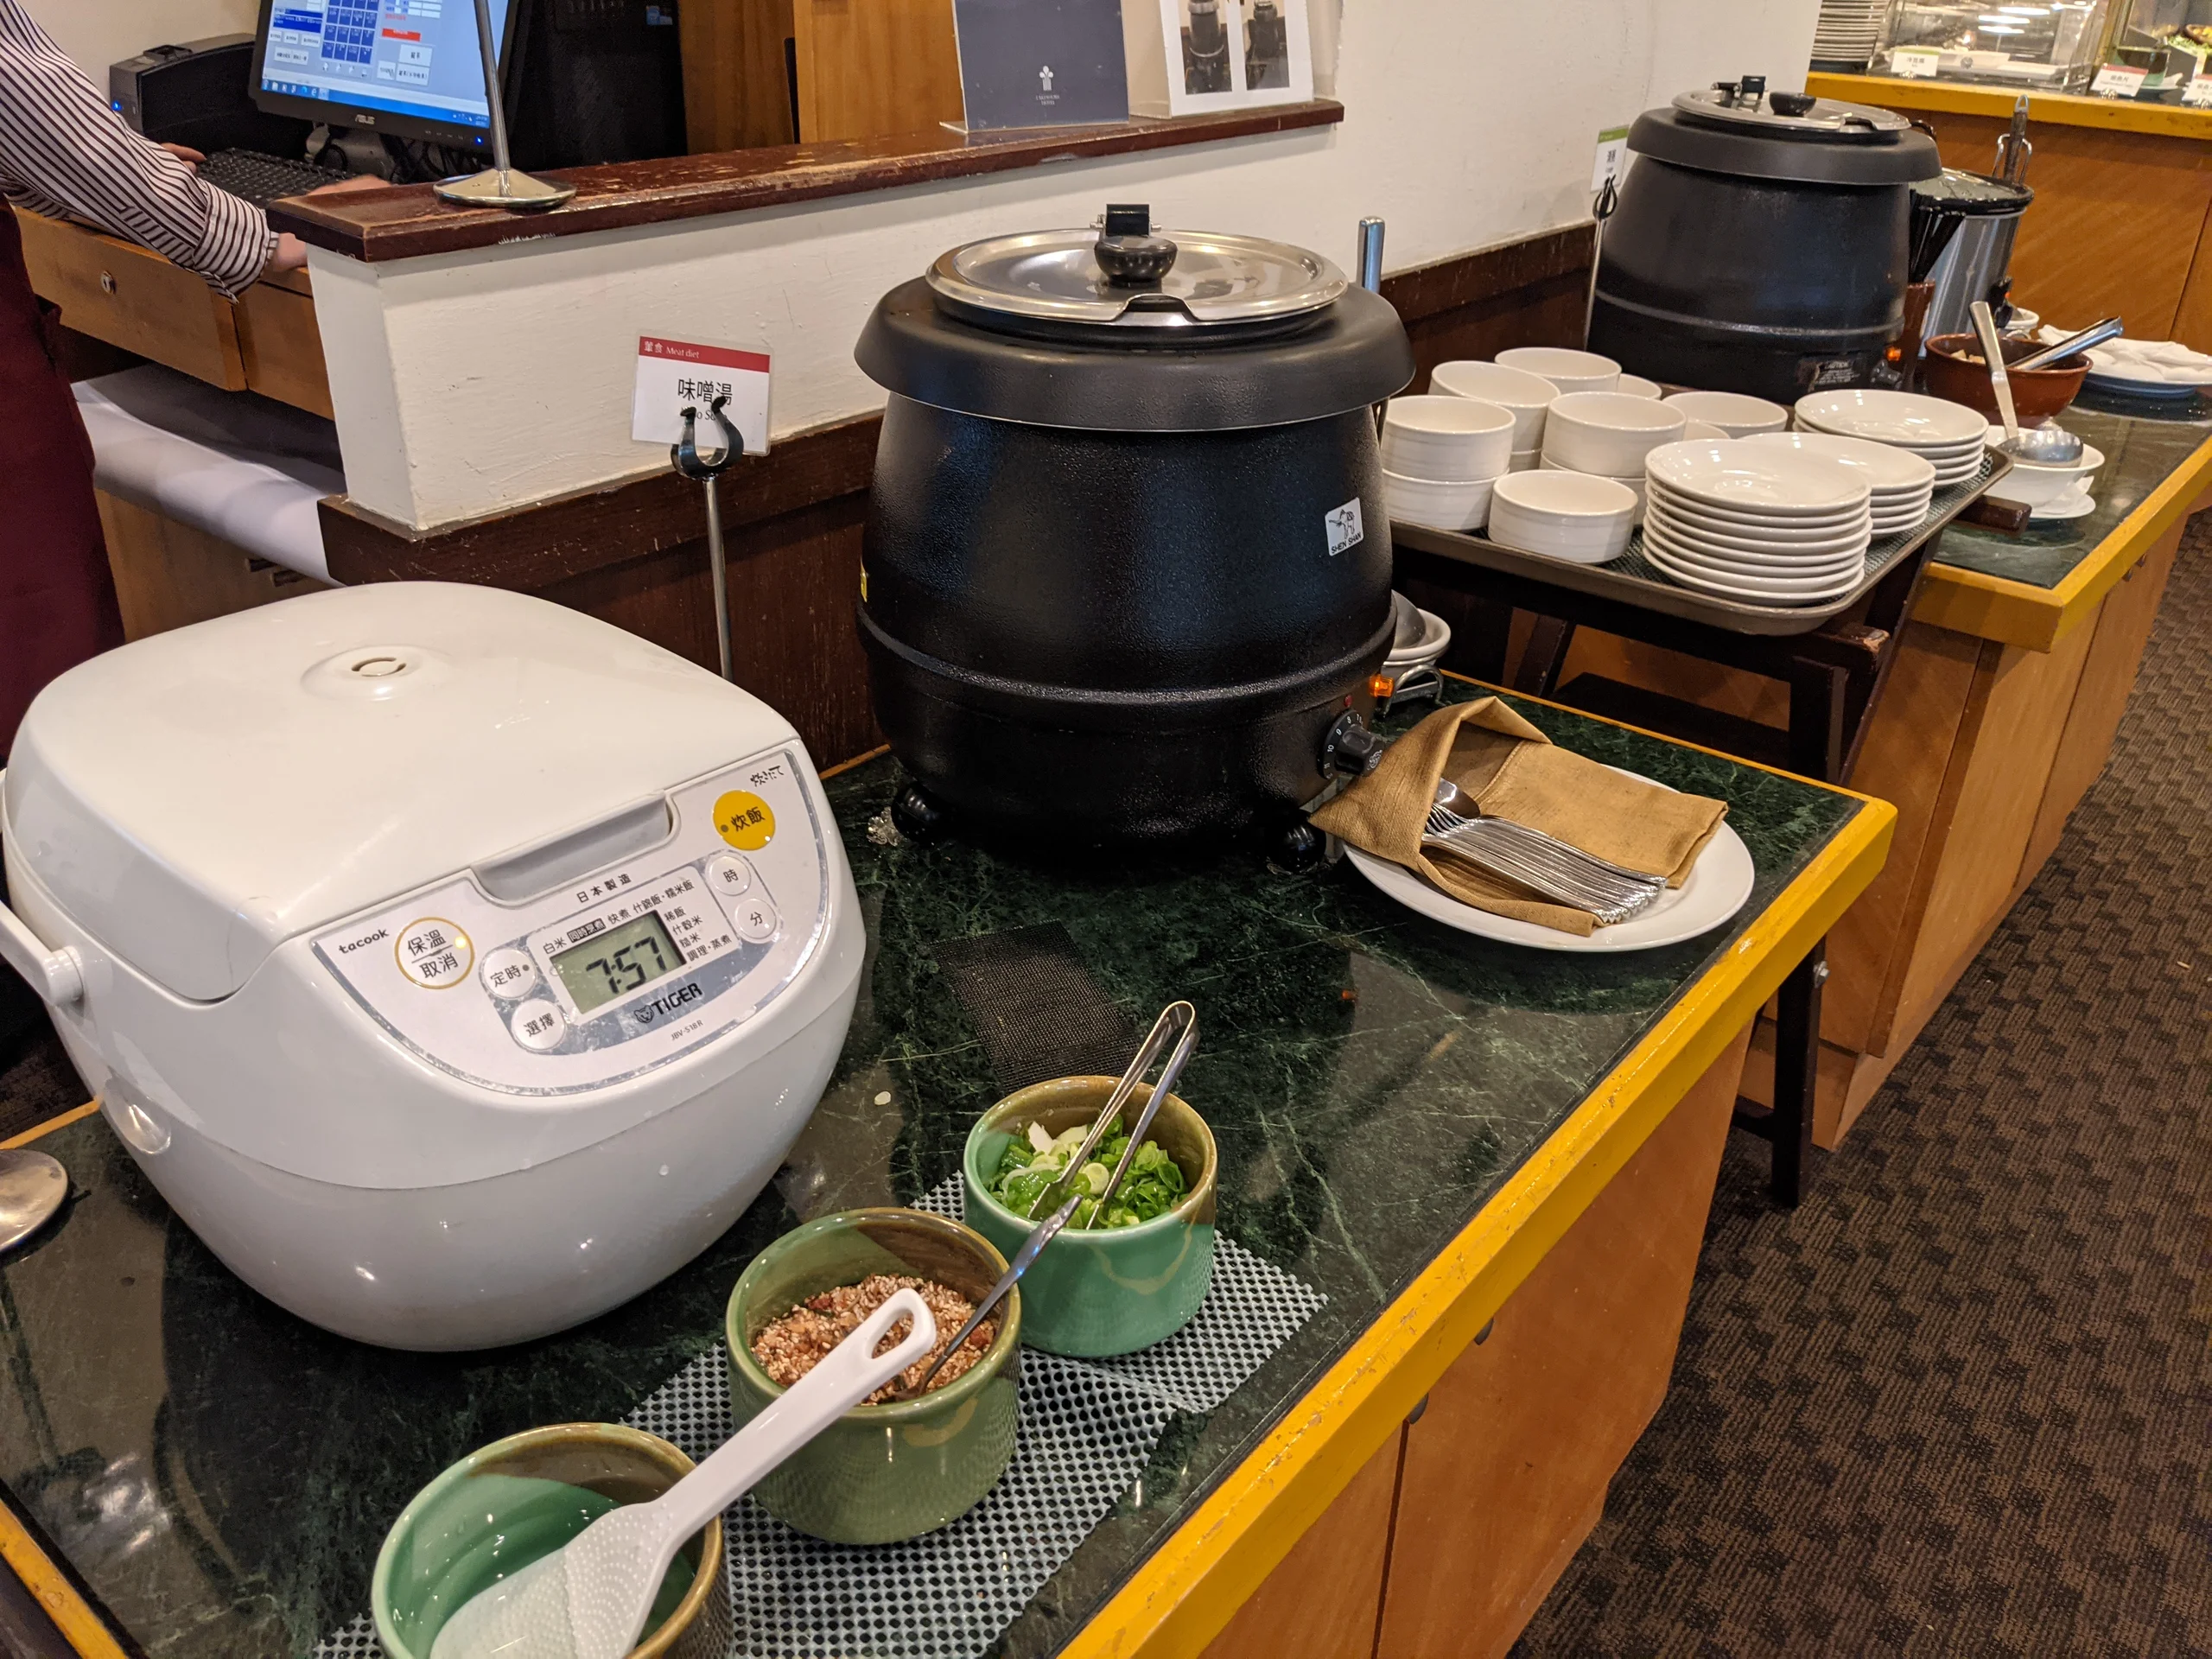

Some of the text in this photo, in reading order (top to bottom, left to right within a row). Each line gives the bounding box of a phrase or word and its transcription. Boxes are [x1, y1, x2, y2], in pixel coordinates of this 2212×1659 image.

[355, 114, 375, 124] ASUS
[665, 346, 700, 359] Meat diet
[677, 378, 733, 406] 味噌湯
[1331, 531, 1362, 554] SHEN SHAN
[1327, 744, 1334, 753] 10
[730, 806, 766, 832] 炊飯
[576, 873, 632, 904] 日本製造
[722, 869, 739, 883] 時
[543, 937, 568, 954] 白米
[607, 908, 632, 925] 快煮
[749, 912, 763, 926] 分
[338, 928, 390, 954] tacook
[407, 929, 447, 956] 保溫
[678, 932, 702, 949] 糙米
[419, 952, 459, 979] 取消
[490, 964, 522, 988] 定時
[586, 936, 667, 995] 7:57
[651, 982, 703, 1015] TIGER
[523, 1013, 556, 1037] 選擇
